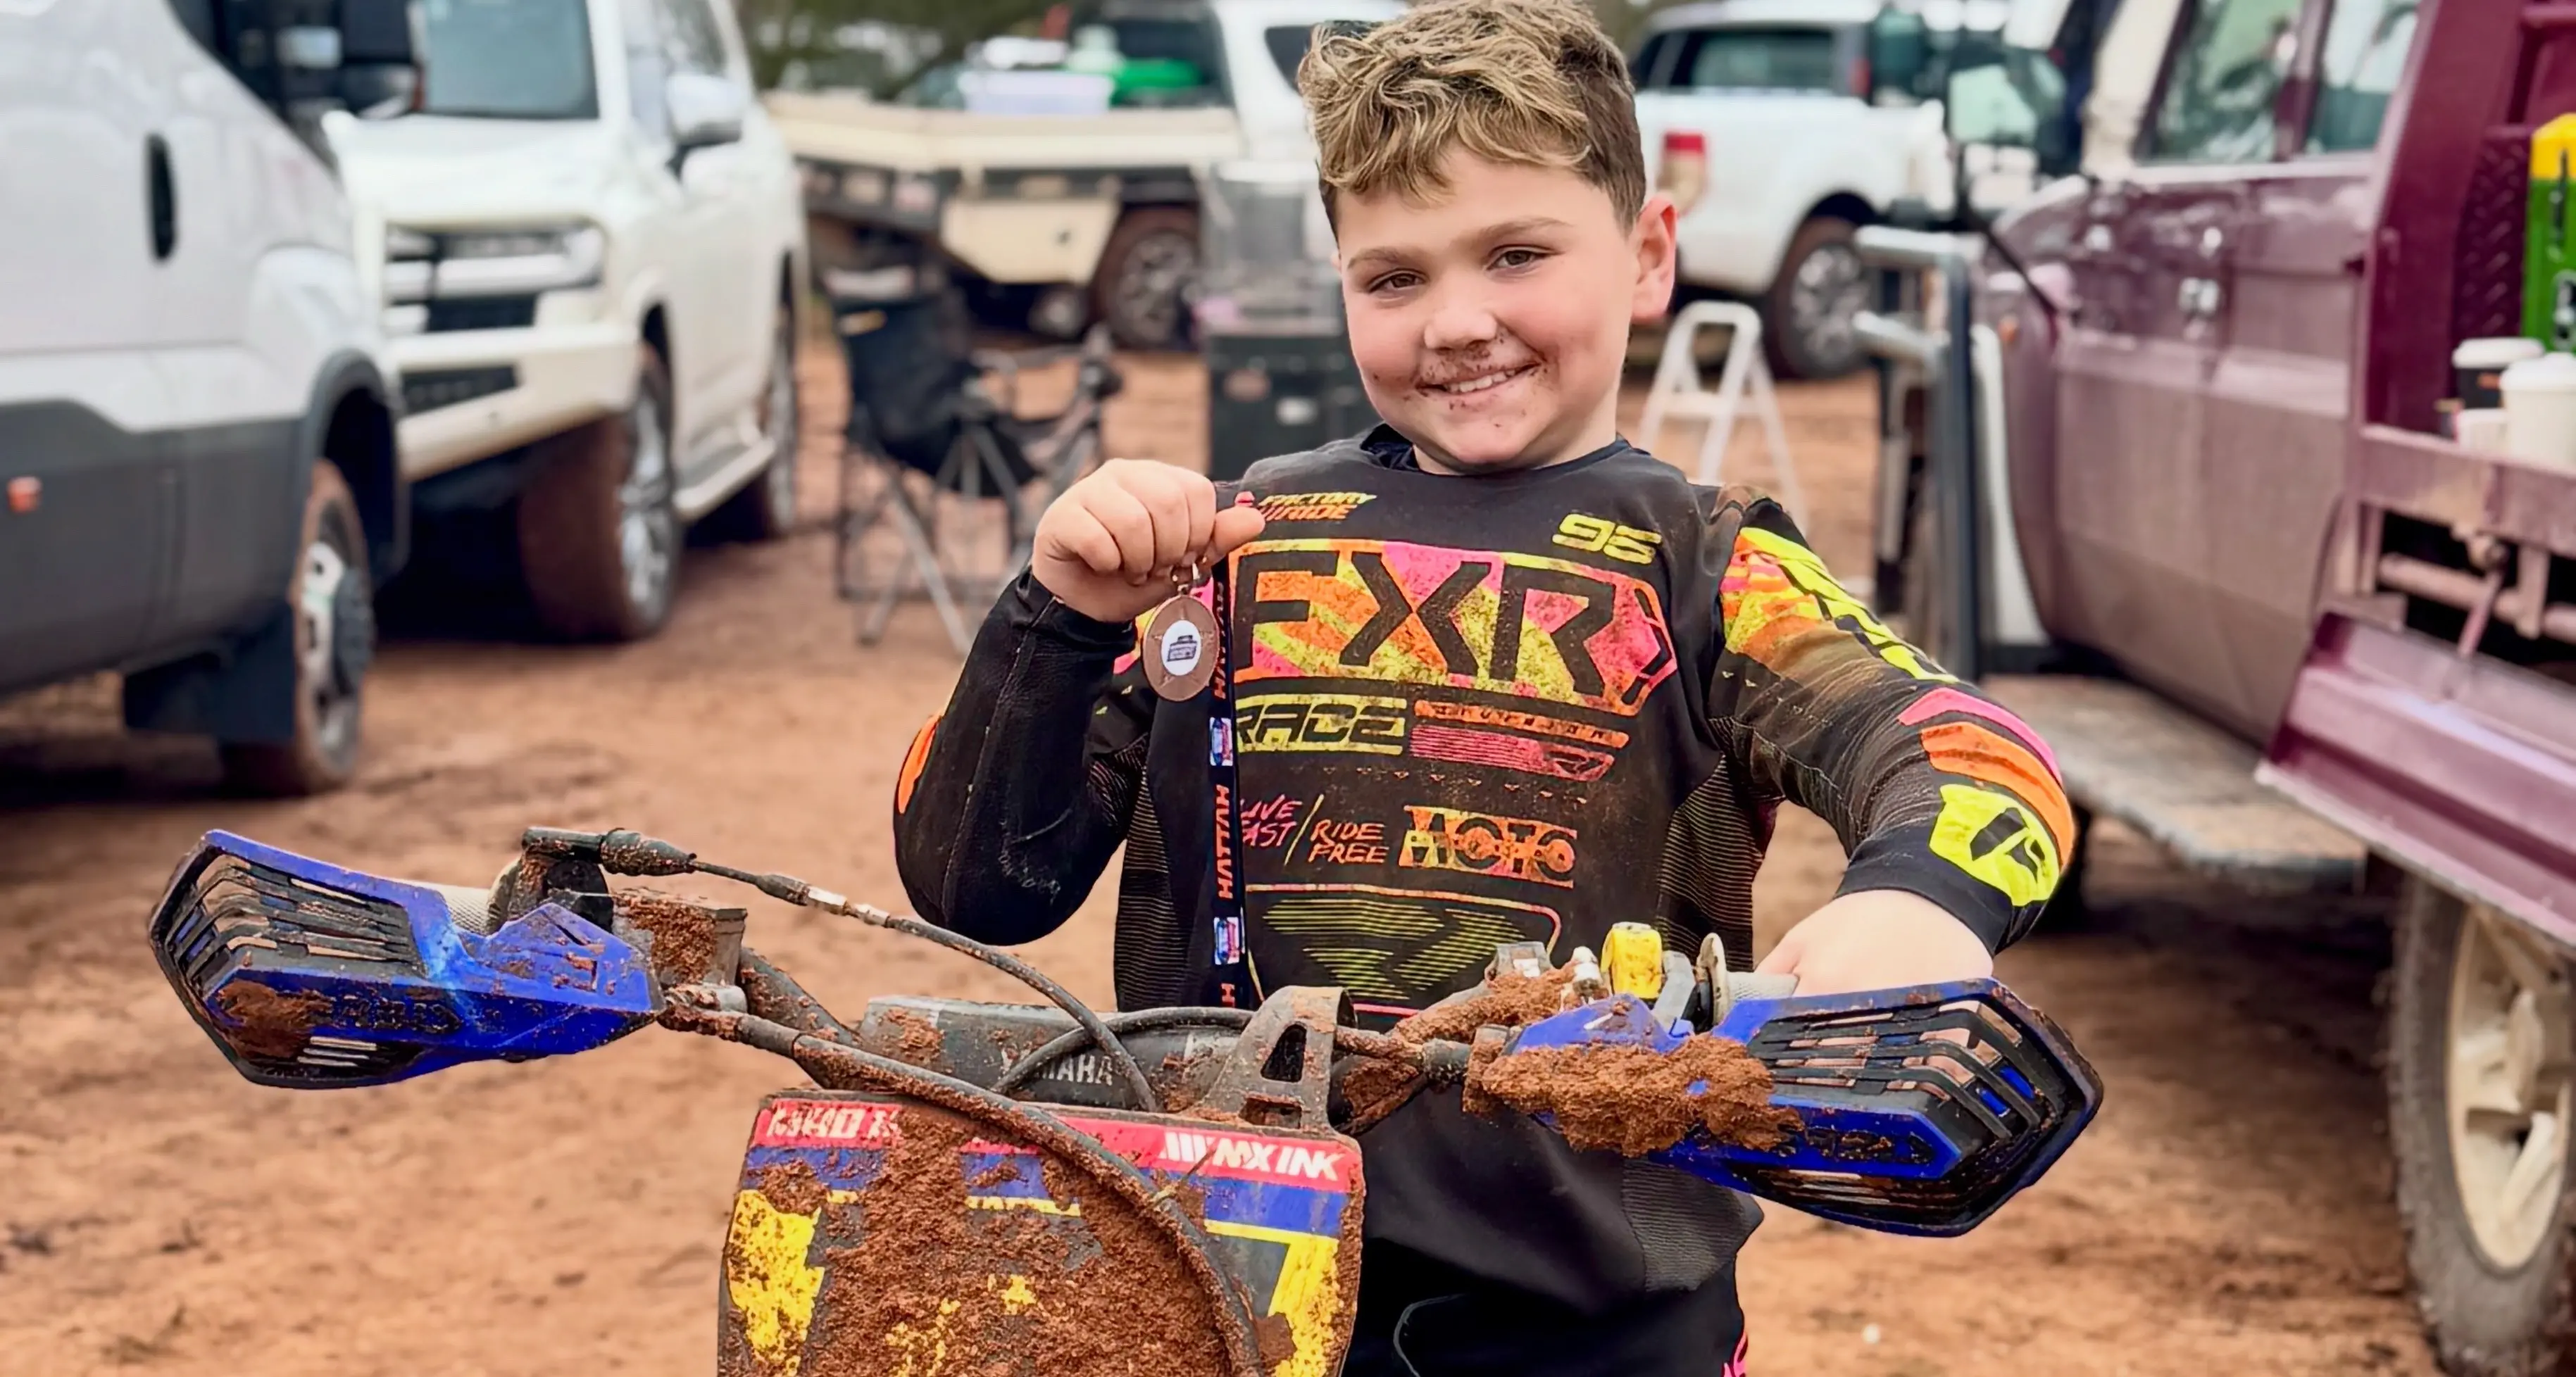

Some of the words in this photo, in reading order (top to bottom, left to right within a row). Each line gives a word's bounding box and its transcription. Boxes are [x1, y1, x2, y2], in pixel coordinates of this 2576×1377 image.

[1232, 551, 1617, 696] FXR
[1236, 703, 1406, 746] RACE
[1215, 784, 1233, 900] HATTAH
[1308, 843, 1390, 864] FREE
[1309, 819, 1387, 845] RIDE
[1401, 809, 1577, 884] MOTO
[1001, 1046, 1113, 1086] YAHA
[1212, 1137, 1278, 1174] MX
[1275, 1145, 1345, 1181] INK
